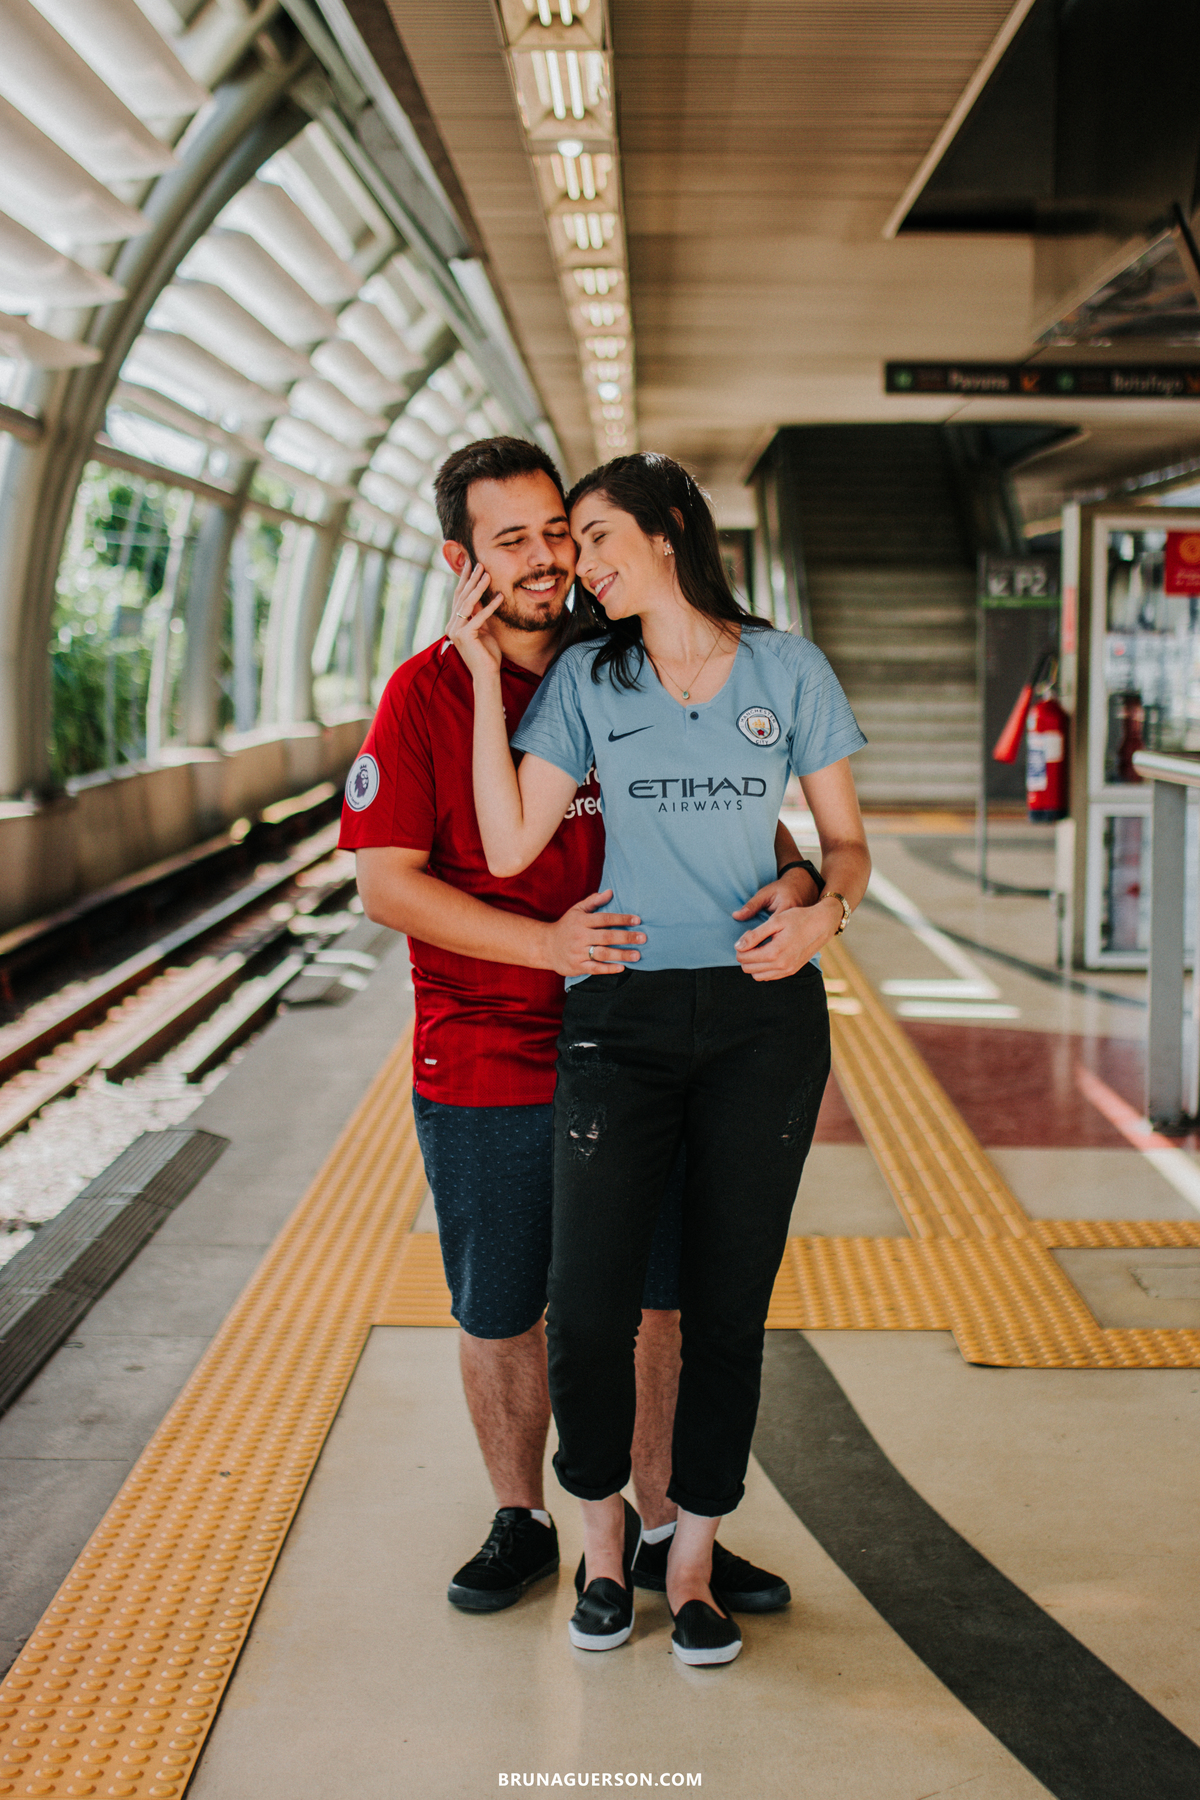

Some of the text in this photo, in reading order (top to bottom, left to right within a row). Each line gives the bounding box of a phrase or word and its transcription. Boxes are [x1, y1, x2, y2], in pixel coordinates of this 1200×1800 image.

[1014, 566, 1046, 596] P2
[741, 709, 776, 723] MANCHESTER
[628, 777, 767, 799] ETIHAD
[658, 800, 743, 813] AIRWAYS
